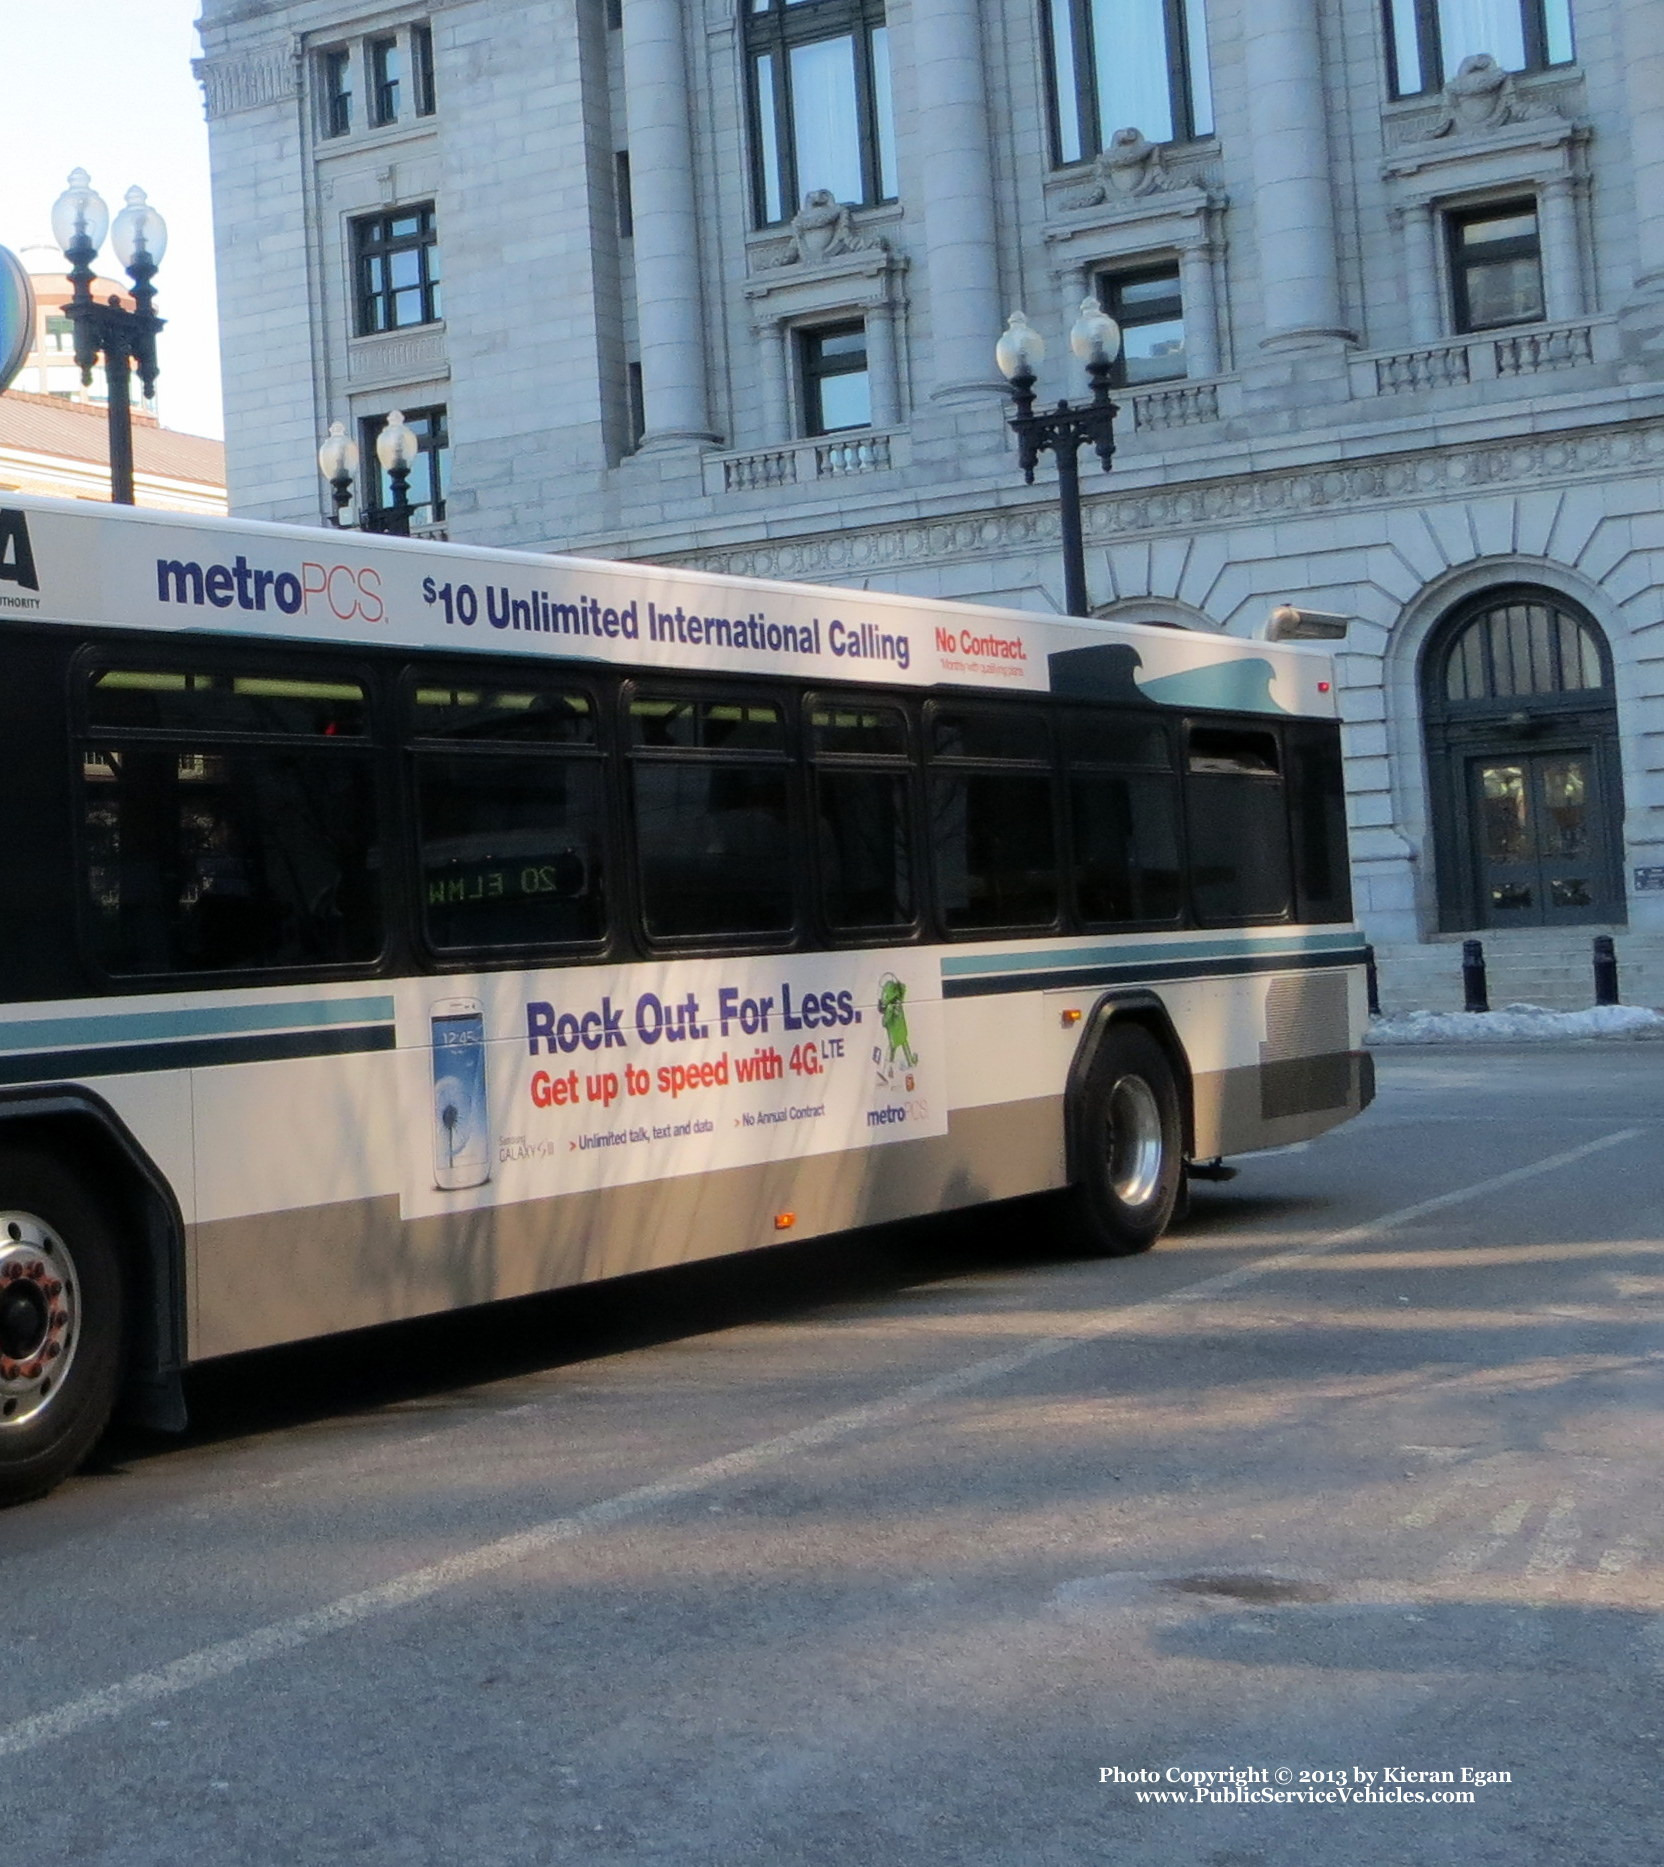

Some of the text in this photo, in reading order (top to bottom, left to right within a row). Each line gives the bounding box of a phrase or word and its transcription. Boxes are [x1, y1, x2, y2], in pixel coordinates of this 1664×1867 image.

[422, 574, 911, 670] $10 Unlimited International Calling
[935, 626, 1027, 660] No Contract.
[526, 982, 863, 1056] Rock Out. For Less.
[530, 1069, 580, 1108] Get
[586, 1071, 619, 1108] up
[624, 1063, 651, 1096] to
[657, 1051, 729, 1099] speed
[735, 1046, 784, 1083] with
[579, 1118, 714, 1151] Unlimited talk, text and data
[742, 1103, 825, 1127] No Annual Contract
